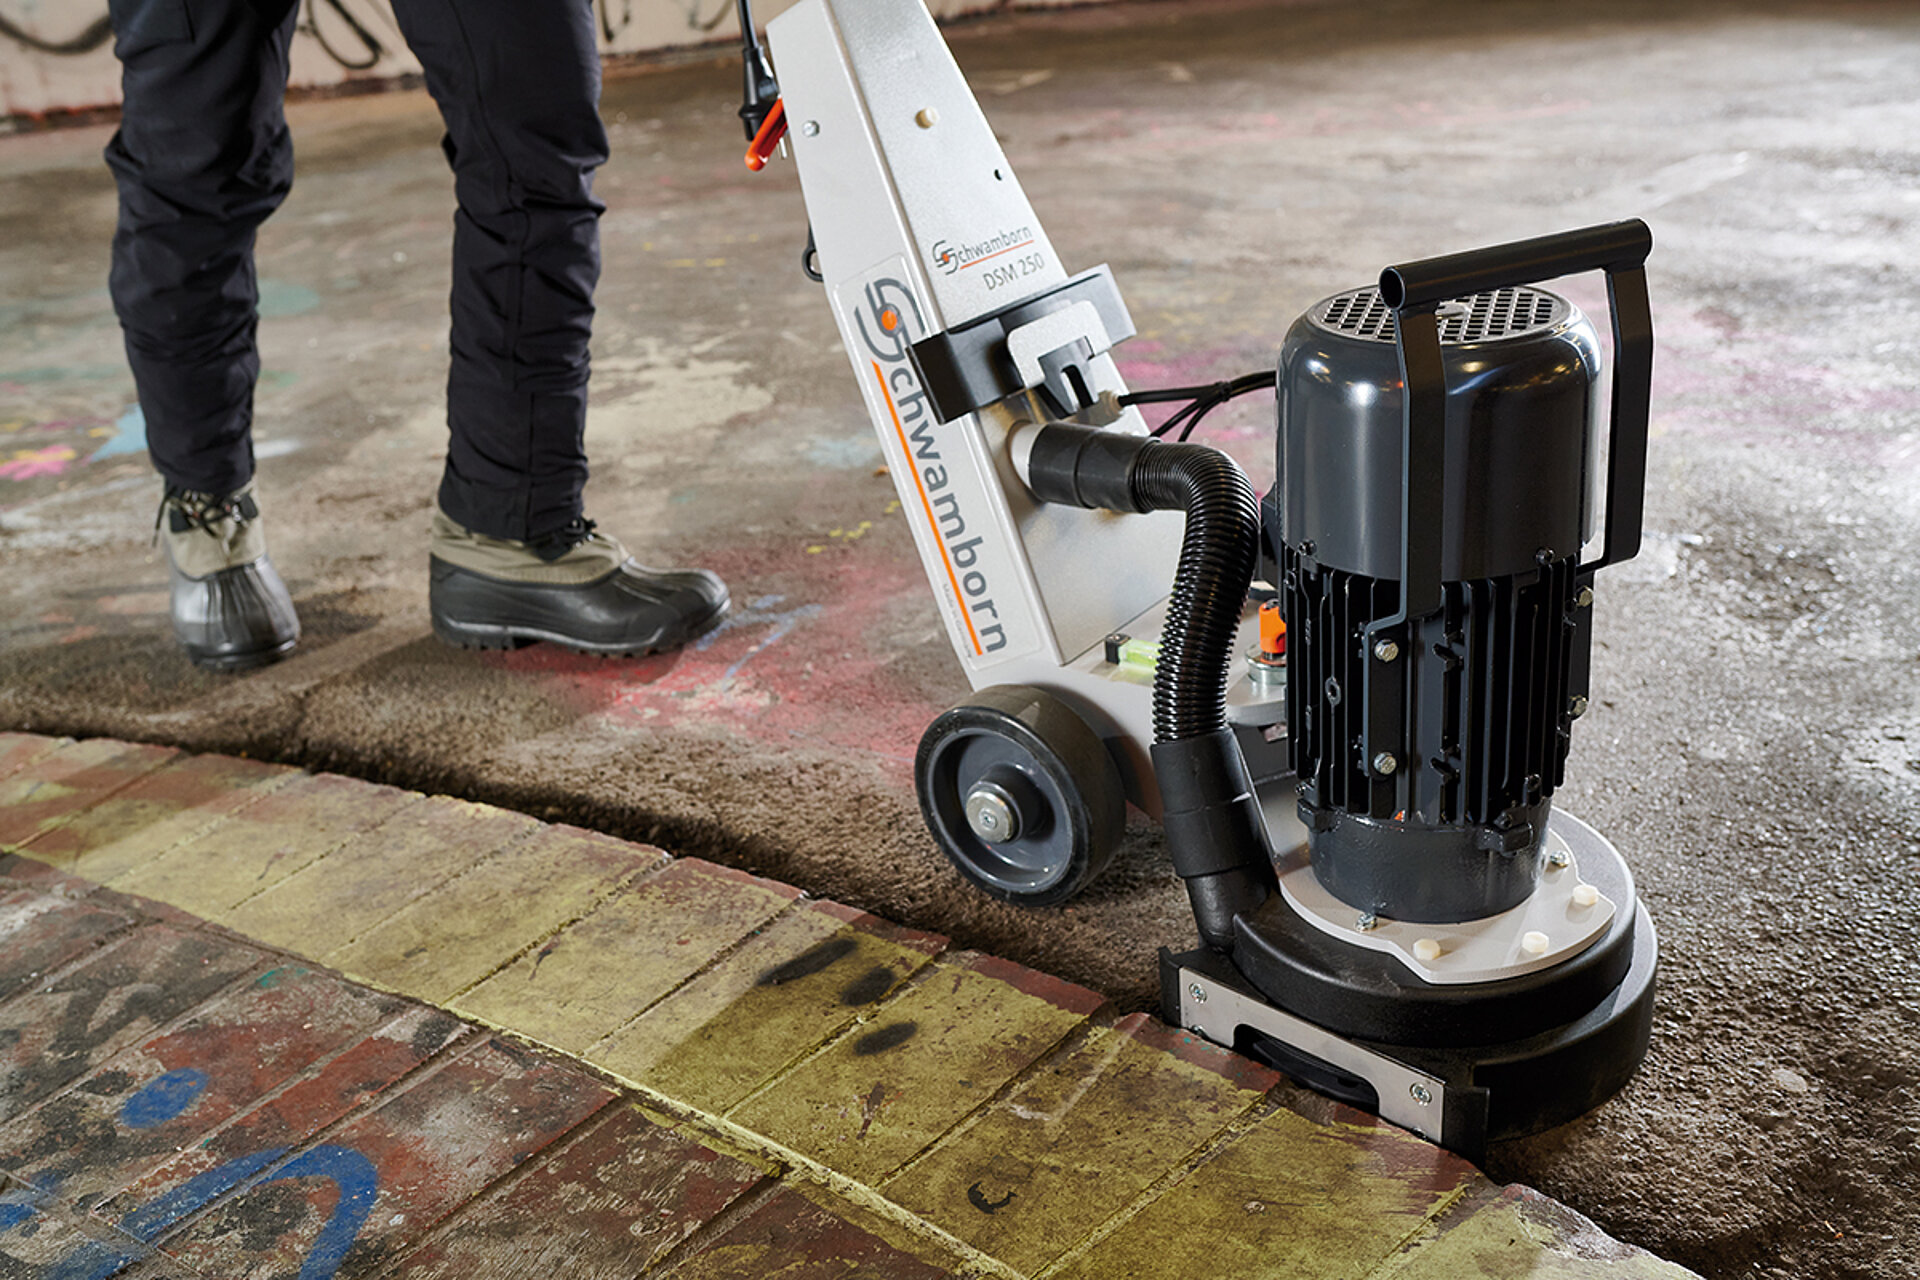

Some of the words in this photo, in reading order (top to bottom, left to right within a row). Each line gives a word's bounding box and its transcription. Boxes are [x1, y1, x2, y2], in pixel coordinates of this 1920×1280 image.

[932, 227, 1033, 275] Schwamborn
[983, 264, 1018, 291] DSM
[1018, 253, 1045, 276] 250
[854, 278, 1007, 653] Schwamborn
